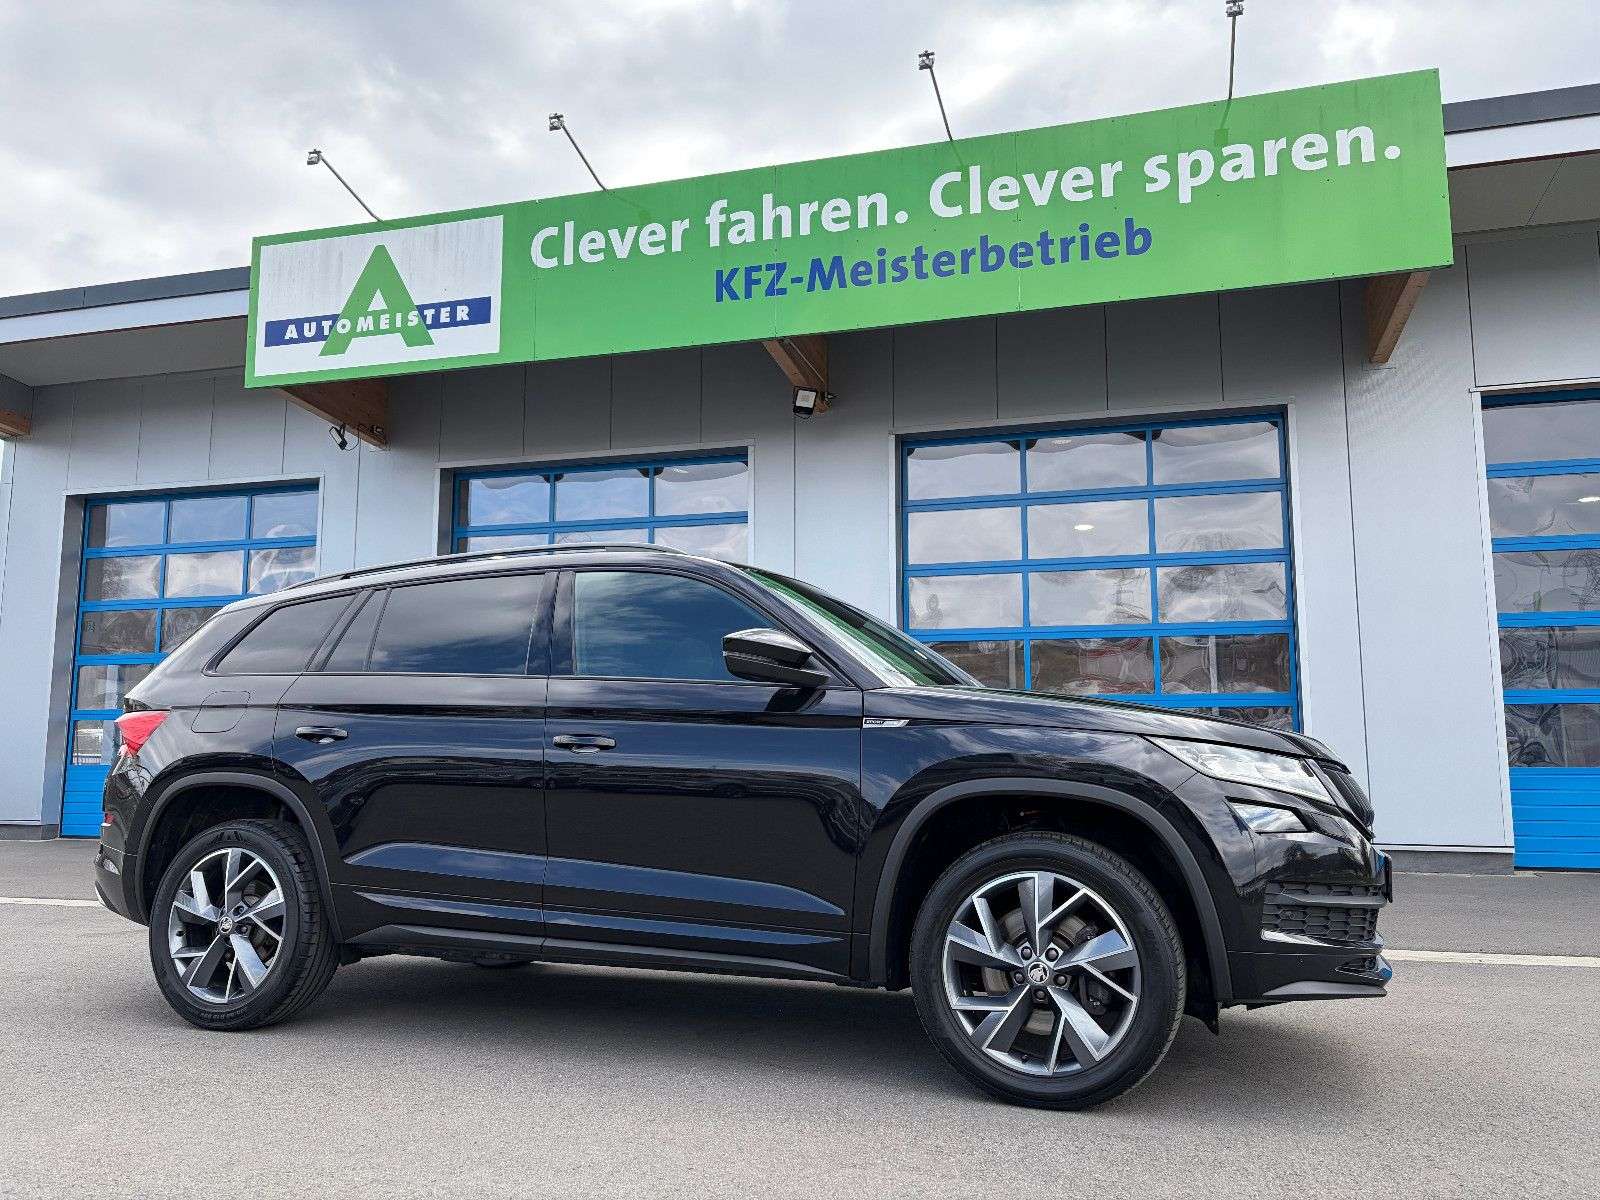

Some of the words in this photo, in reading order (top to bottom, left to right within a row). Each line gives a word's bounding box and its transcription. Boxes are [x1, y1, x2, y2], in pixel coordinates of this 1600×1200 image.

[530, 218, 690, 269] Clever
[705, 193, 909, 249] fahren.
[929, 160, 1123, 219] Clever
[1143, 125, 1401, 204] sparen.
[715, 218, 1152, 303] KFZ-Meisterbetrieb
[284, 305, 471, 340] AUTOMEISTER
